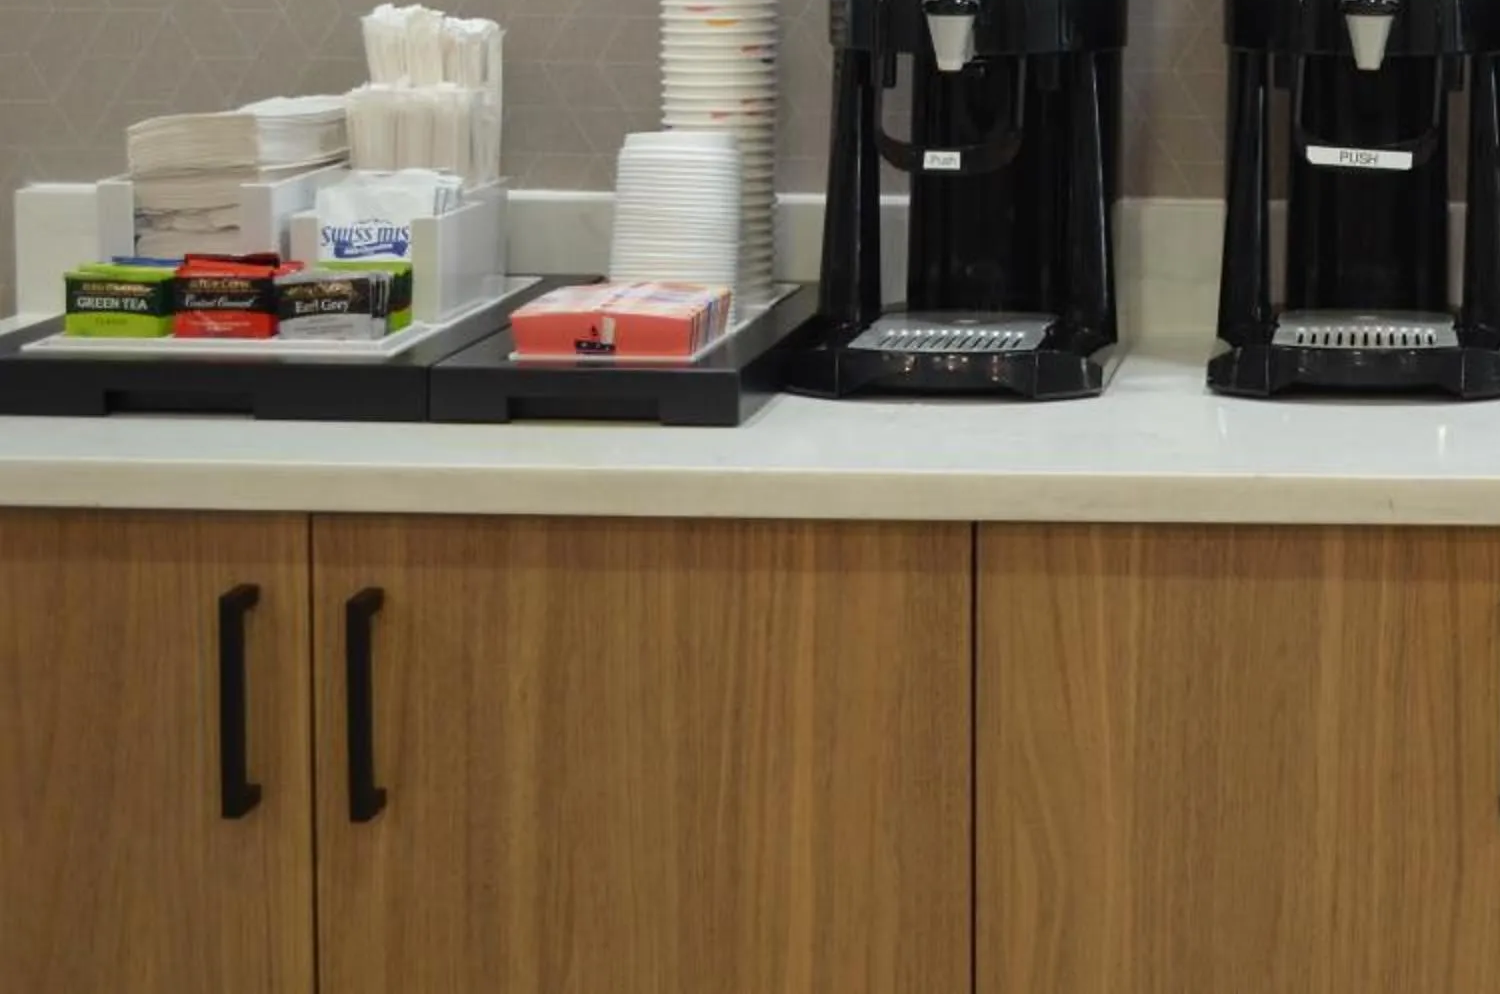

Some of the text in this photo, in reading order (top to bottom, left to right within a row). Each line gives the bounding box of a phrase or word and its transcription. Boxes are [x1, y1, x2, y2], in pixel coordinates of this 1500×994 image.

[1339, 150, 1379, 164] PUSH
[77, 297, 148, 311] GREEN TEA
